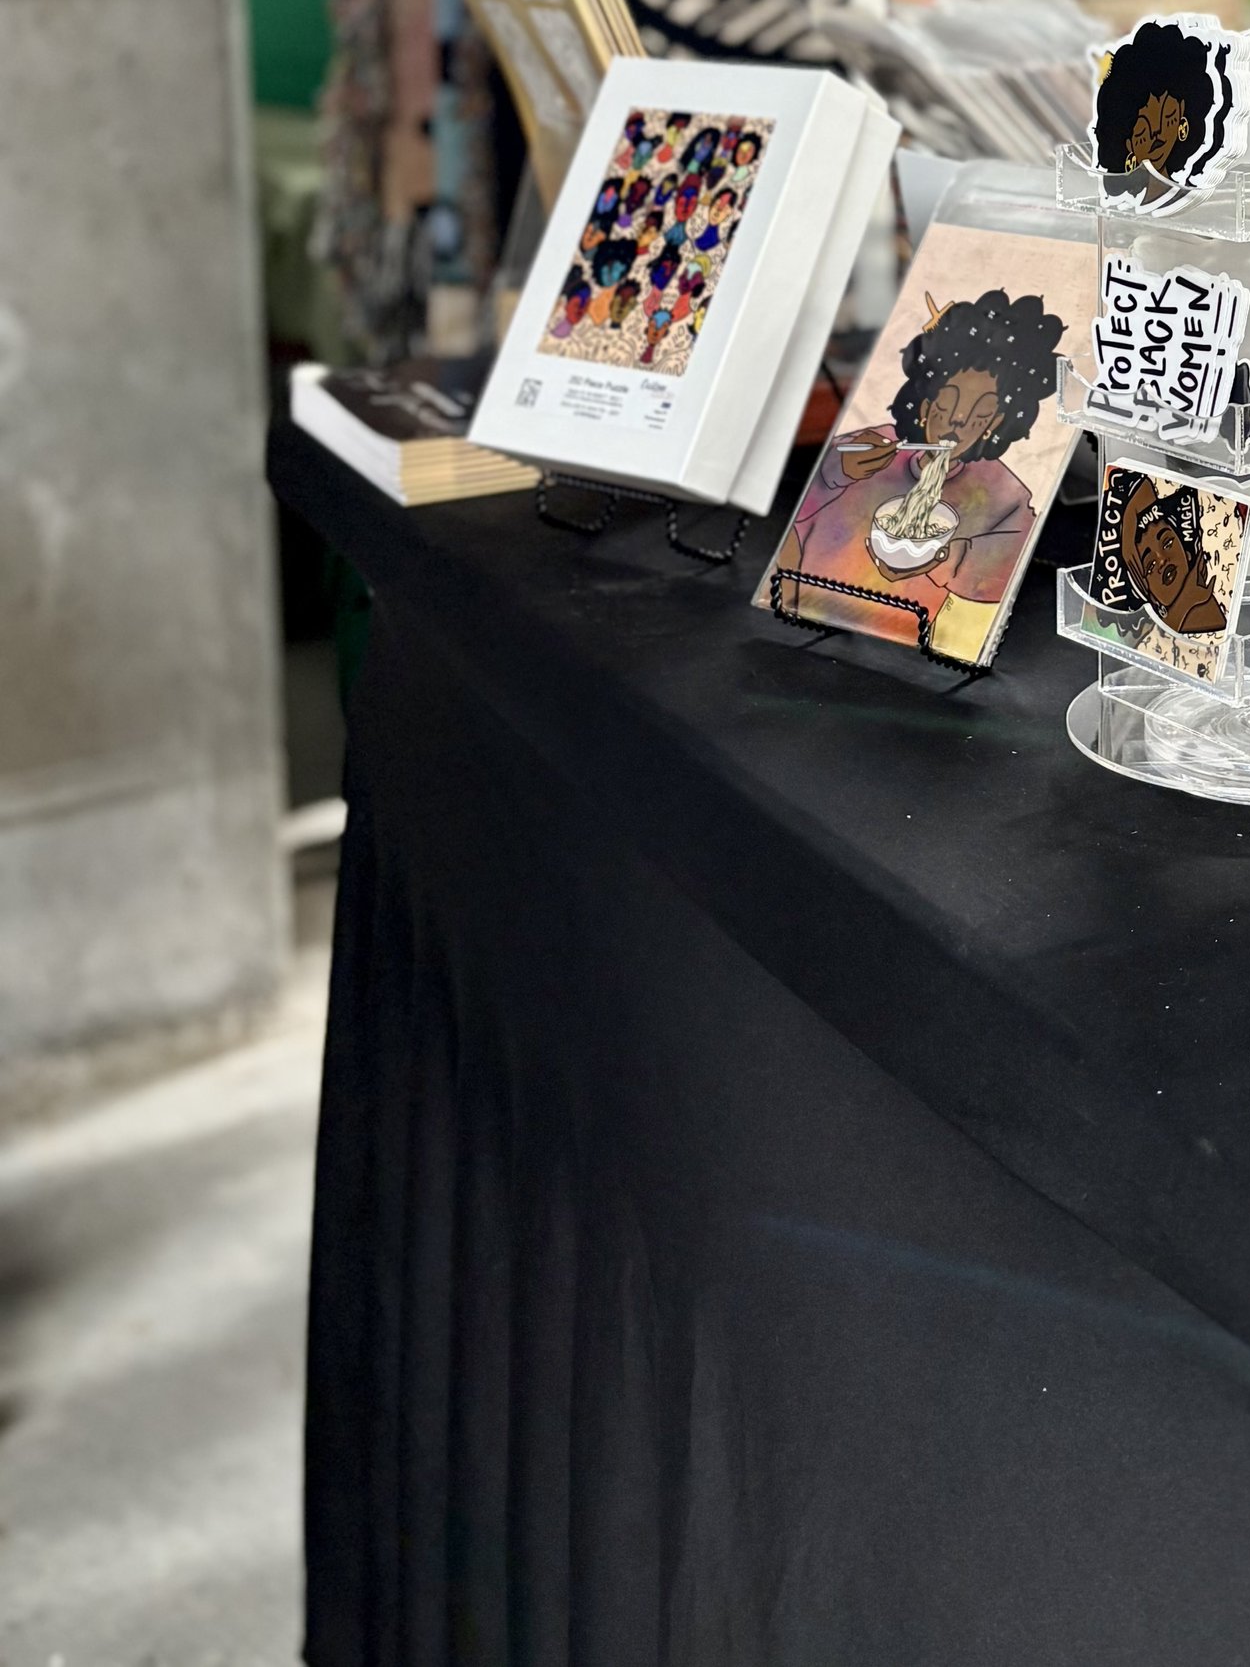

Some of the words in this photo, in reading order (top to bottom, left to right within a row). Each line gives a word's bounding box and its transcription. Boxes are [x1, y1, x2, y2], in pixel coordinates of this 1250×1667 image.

[1133, 279, 1179, 412] BLACK
[1162, 276, 1212, 431] WOMEN
[1099, 491, 1127, 605] PROTECT
[1138, 505, 1164, 529] YOUR
